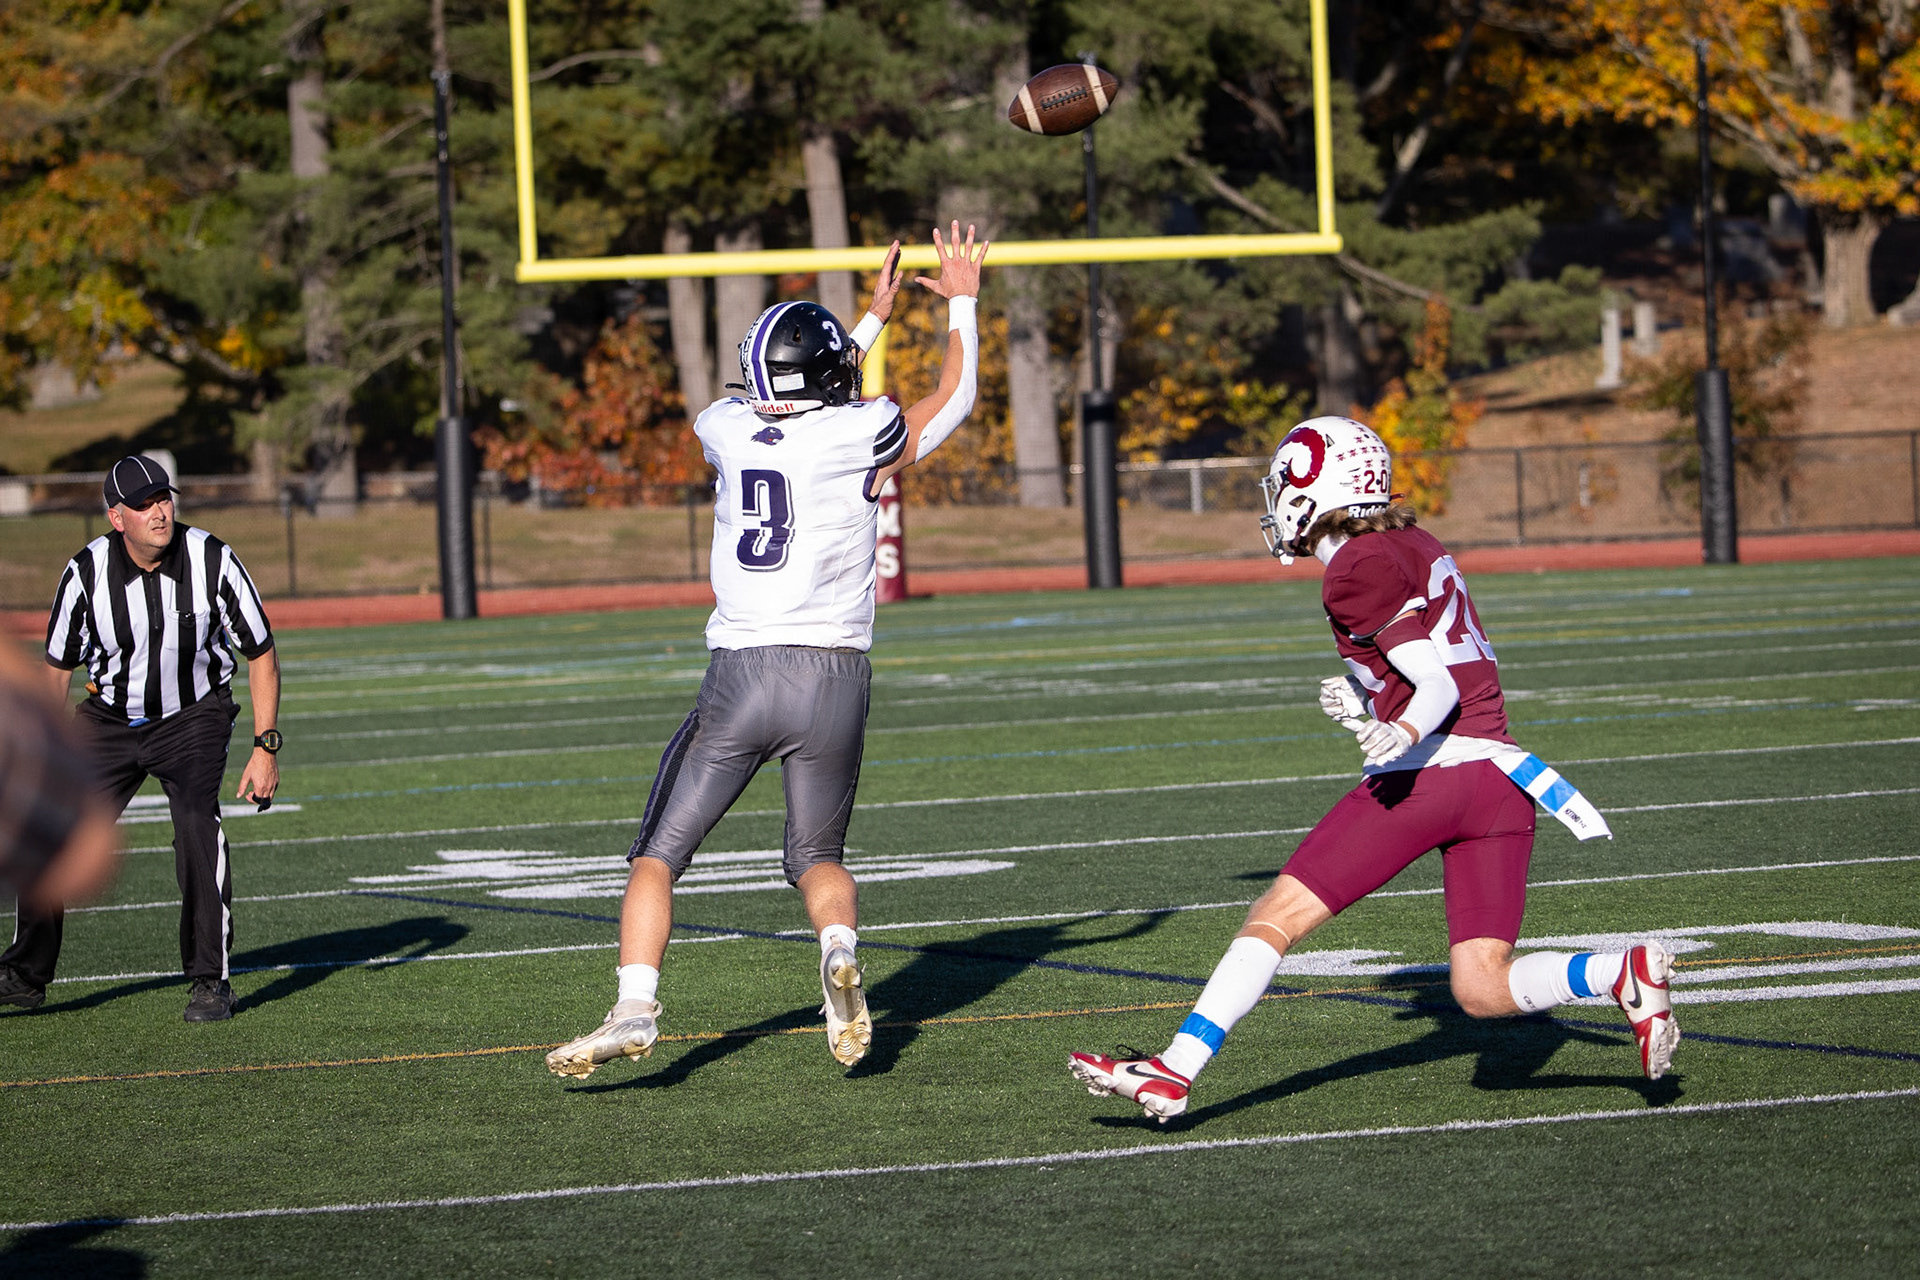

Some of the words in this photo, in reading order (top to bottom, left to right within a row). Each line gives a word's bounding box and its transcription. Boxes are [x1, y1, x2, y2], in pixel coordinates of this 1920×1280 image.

[822, 320, 842, 351] 3
[1363, 469, 1388, 494] 20
[736, 468, 796, 573] 3
